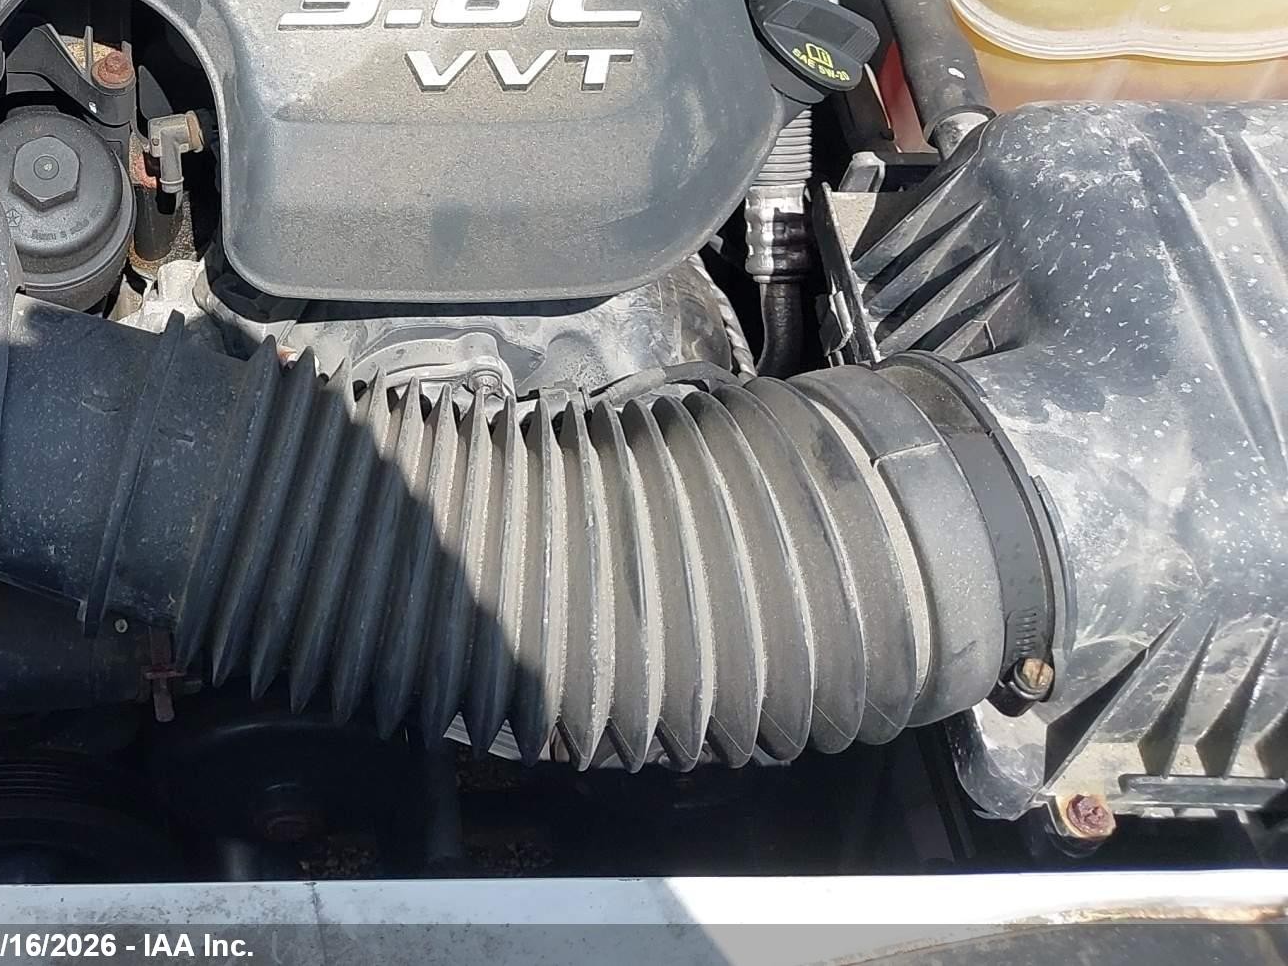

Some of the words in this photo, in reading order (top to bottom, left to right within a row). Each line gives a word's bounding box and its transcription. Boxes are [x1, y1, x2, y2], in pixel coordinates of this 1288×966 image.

[404, 49, 634, 92] VVT
[792, 48, 816, 69] SAE
[817, 64, 851, 81] 5W-20
